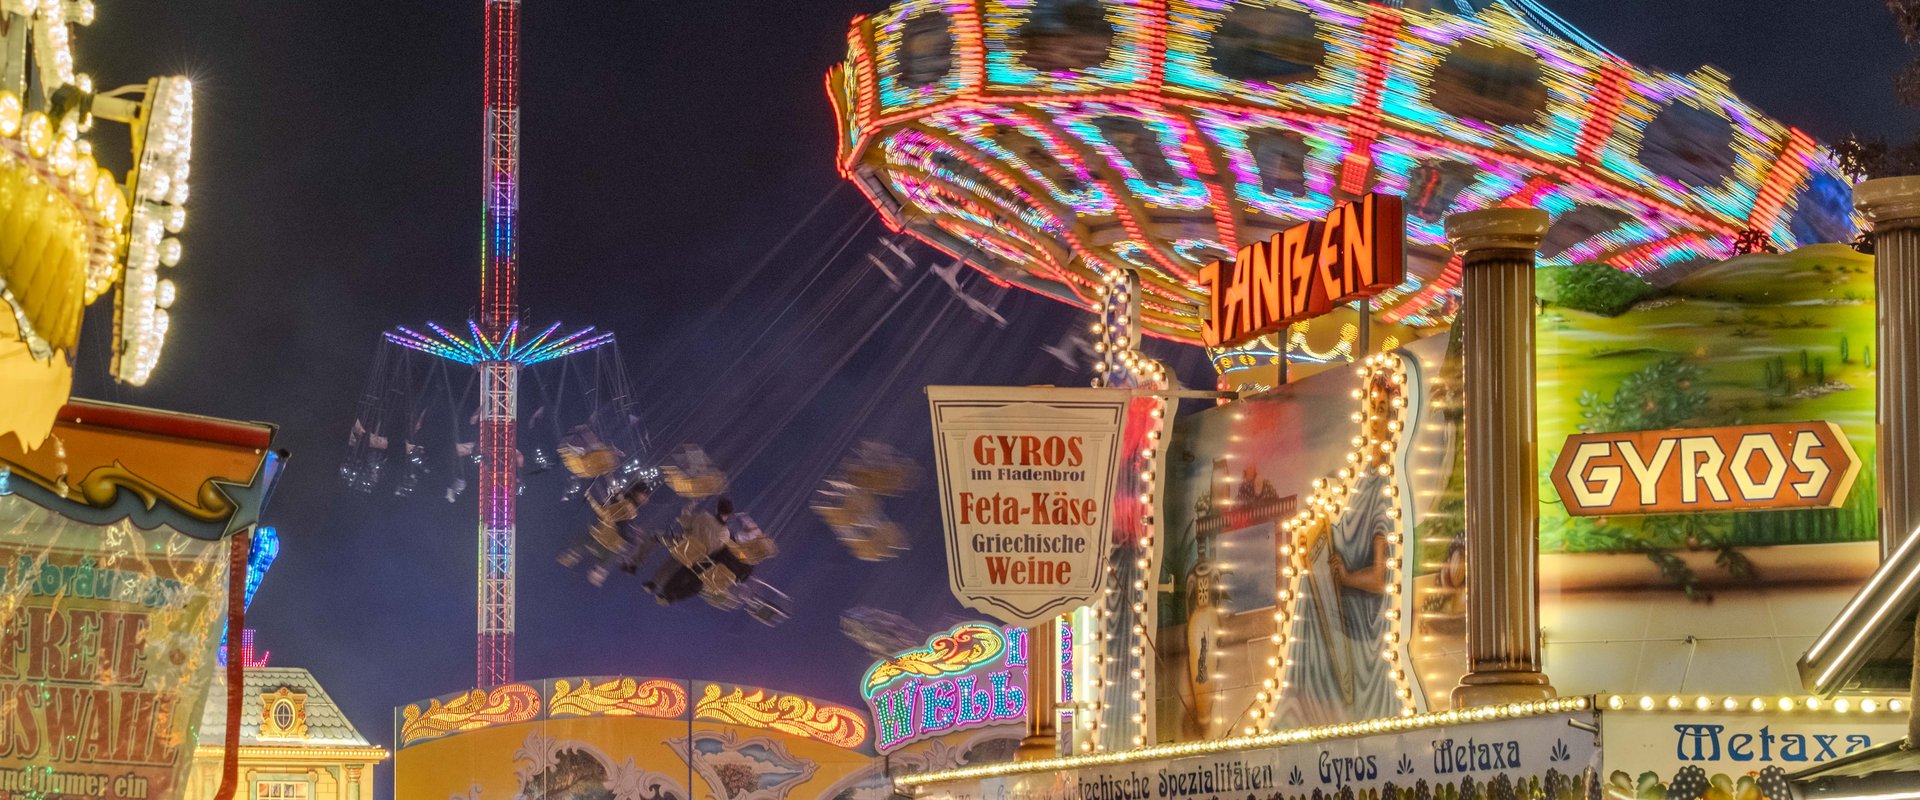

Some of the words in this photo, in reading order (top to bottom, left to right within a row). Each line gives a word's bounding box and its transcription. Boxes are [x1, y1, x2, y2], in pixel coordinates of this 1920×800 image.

[973, 434, 1083, 467] GYROS
[971, 468, 992, 480] im
[998, 468, 1085, 481] Fladenbrot
[1565, 430, 1832, 508] GYROS
[959, 491, 1097, 526] Feta-Käse
[972, 533, 1086, 554] Griechische
[985, 556, 1072, 585] Weine
[1158, 761, 1274, 800] Spezialitäten
[1318, 750, 1378, 790] Gyros
[1431, 737, 1521, 774] Metaxa
[114, 772, 149, 800] ein
